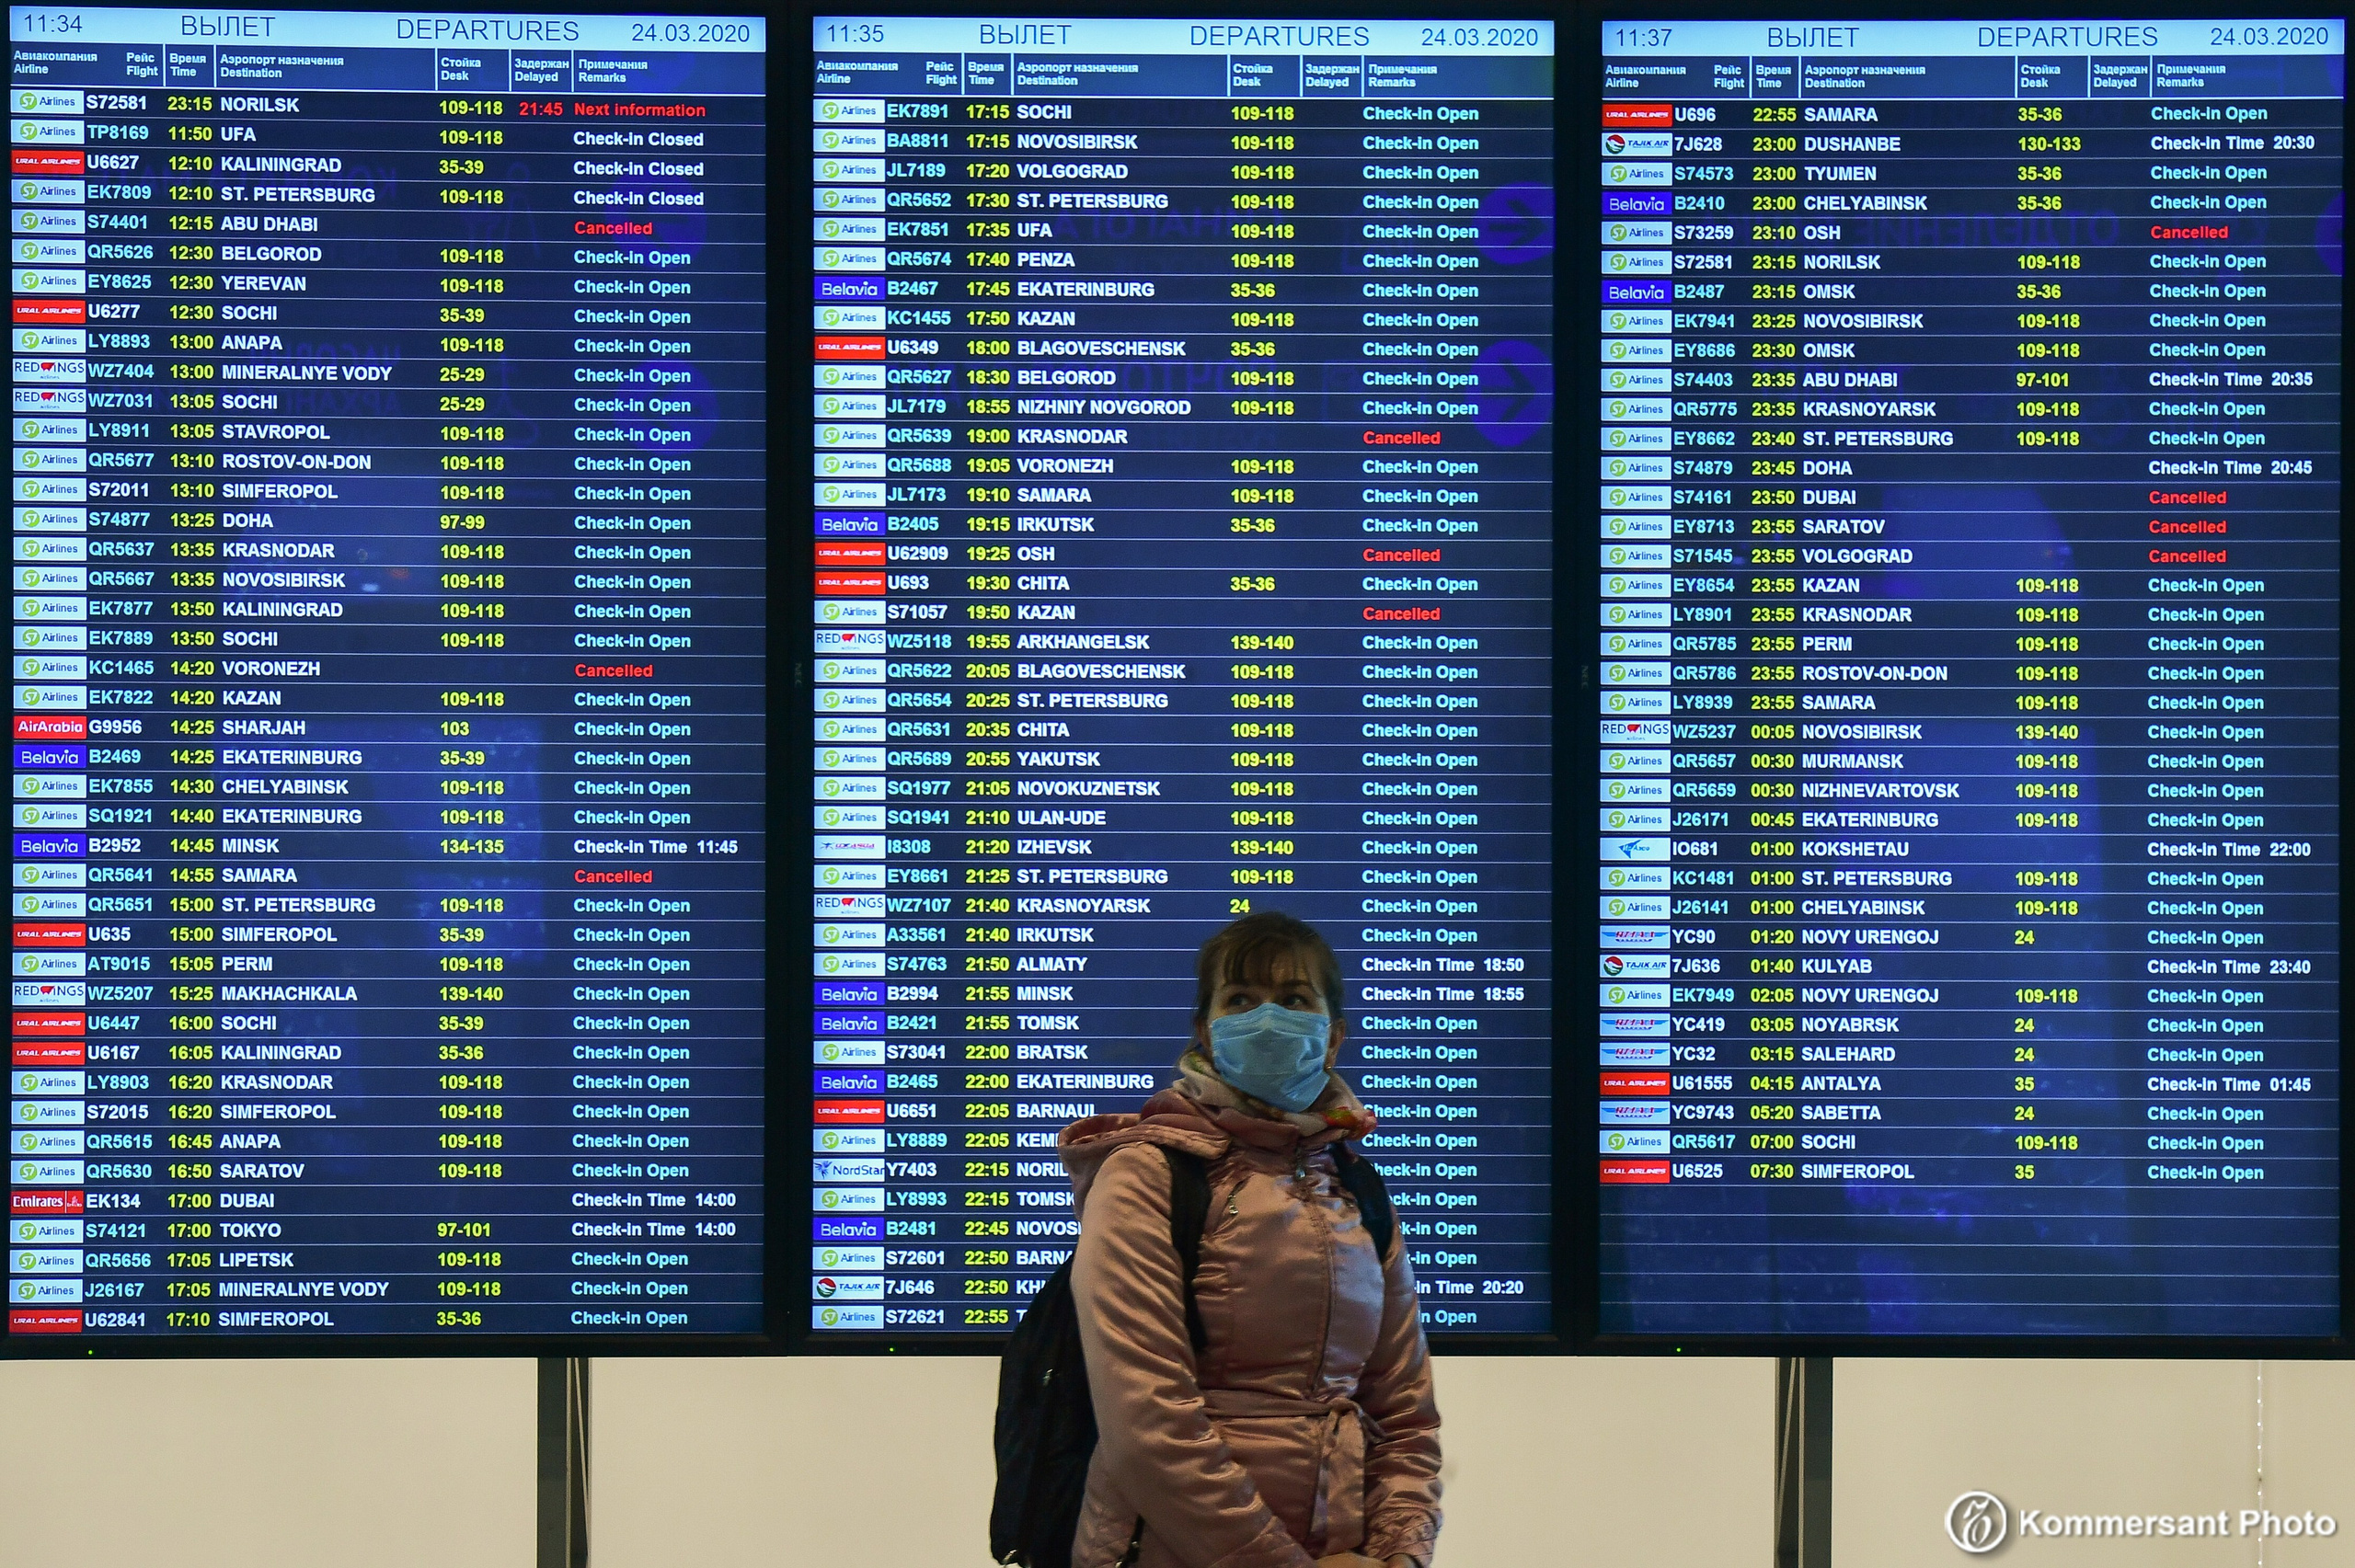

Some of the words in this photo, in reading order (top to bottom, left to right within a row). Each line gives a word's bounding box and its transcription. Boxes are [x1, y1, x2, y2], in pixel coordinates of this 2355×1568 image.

[25, 14, 82, 32] 11:34
[182, 16, 275, 37] ВЫЛЕТ
[397, 19, 579, 40] DEPARTURES
[632, 24, 750, 42] 24.03.2020
[828, 25, 883, 42] 11:35
[981, 25, 1072, 44] ВЫЛЕТ
[1191, 26, 1369, 46] DEPARTURES
[1422, 29, 1538, 46] 24.03.2020
[1616, 29, 1672, 46] 11:37
[1768, 28, 1859, 47] ВЫЛЕТ
[1979, 27, 2157, 47] DEPARTURES
[2211, 27, 2328, 45] 24.03.2020
[14, 51, 98, 61] Авиакомпания
[127, 52, 155, 63] Рейс
[170, 53, 206, 64] Время
[220, 54, 276, 66] Аэропорт
[278, 57, 343, 65] назначения
[442, 57, 481, 67] Стойка
[515, 58, 569, 70] Задержан
[579, 59, 648, 71] Примечания
[817, 61, 898, 71] Авиакомпания
[926, 62, 954, 71] Рейс
[968, 62, 1004, 73] Время
[14, 63, 48, 74] Airline
[127, 65, 158, 77] Flight
[170, 66, 196, 76] Time
[221, 67, 281, 77] Destination
[1017, 63, 1072, 74] Аэропорт
[1074, 64, 1138, 73] назначения
[1234, 63, 1273, 73] Стойка
[1305, 63, 1360, 75] Задержан
[1369, 64, 1437, 75] Примечания
[1606, 65, 1686, 74] Авиакомпания
[1715, 65, 1741, 74] Рейс
[1756, 65, 1791, 76] Время
[1805, 65, 1859, 76] Аэропорт
[2021, 64, 2061, 74] Стойка
[2094, 64, 2148, 75] Задержан
[2157, 64, 2225, 75] Примечания
[442, 71, 468, 80] Desk
[515, 72, 558, 83] Delayed
[579, 73, 626, 82] Remarks
[817, 74, 851, 83] Airline
[926, 74, 957, 86] Flight
[969, 74, 994, 85] Time
[1017, 75, 1078, 85] Destination
[1234, 76, 1261, 86] Desk
[1305, 77, 1349, 88] Delayed
[1369, 77, 1416, 86] Remarks
[1605, 78, 1638, 87] Airline
[1715, 78, 1744, 89] Flight
[1756, 78, 1781, 87] Time
[1805, 78, 1865, 87] Destination
[2021, 77, 2048, 87] Desk
[2094, 77, 2137, 89] Delayed
[2157, 77, 2204, 86] Remarks
[39, 96, 75, 107] Airlines
[86, 94, 146, 110] S72581
[167, 96, 213, 111] 23:15
[220, 97, 300, 113] NORILSK
[439, 99, 503, 115] 109-118
[519, 101, 564, 117] 21:45
[574, 102, 610, 116] Next
[615, 102, 706, 117] information
[841, 106, 877, 115] Airlines
[887, 103, 948, 119] EK7891
[966, 104, 1010, 120] 17:15
[1017, 104, 1072, 120] SOCHI
[1231, 106, 1294, 120] 109-118
[1362, 106, 1433, 120] Check-in
[1436, 106, 1479, 124] Open
[1673, 136, 1723, 152] 7J628
[1752, 136, 1797, 152] 23:00
[1804, 136, 1901, 152] DUSHANBE
[2018, 136, 2082, 152] 130-133
[2150, 135, 2221, 151] Check-in
[2225, 135, 2265, 150] Time
[2273, 135, 2315, 150] 20:30
[1628, 227, 1664, 237] Airlines
[1673, 224, 1734, 240] S73259
[1752, 225, 1797, 240] 23:10
[1803, 224, 1841, 240] OSH
[2150, 225, 2229, 239] Cancelled
[887, 545, 949, 561] U62909
[966, 545, 1011, 561] 19:25
[1017, 546, 1055, 562] OSH
[1362, 548, 1442, 562] Cancelled
[17, 720, 83, 733] AirArabia
[88, 719, 143, 735] G9956
[170, 719, 215, 735] 14:25
[222, 719, 306, 736] SHARJAH
[440, 721, 470, 736] 103
[574, 721, 645, 736] Check-in
[649, 722, 692, 739] Open
[1671, 724, 1737, 739] WZ5237
[1751, 724, 1795, 739] 00:05
[1802, 724, 1923, 739] NOVOSIBIRSK
[2015, 725, 2079, 739] 139-140
[2147, 725, 2218, 739] Check-in
[2222, 725, 2265, 742] Open
[842, 812, 878, 822] Airlines
[887, 809, 949, 825] SQ1941
[965, 809, 1010, 825] 21:10
[1017, 809, 1107, 826] ULAN-UDE
[1230, 810, 1294, 826] 109-118
[1361, 810, 1432, 826] Check-in
[1435, 811, 1478, 829] Open
[21, 838, 78, 853] Belavia
[88, 837, 142, 853] B2952
[170, 838, 214, 853] 14:45
[222, 838, 280, 853] MINSK
[440, 839, 504, 854] 134-135
[573, 839, 644, 853] Check-in
[648, 839, 688, 854] Time
[696, 840, 739, 854] 11:45
[821, 986, 878, 1001] Belavia
[887, 986, 939, 1001] B2994
[965, 986, 1010, 1001] 21:55
[1017, 986, 1074, 1001] MINSK
[1361, 986, 1431, 1001] Check-in
[1435, 987, 1476, 1001] Time
[1483, 987, 1525, 1001] 18:55
[1671, 1163, 1724, 1179] U6525
[1750, 1163, 1794, 1179] 07:30
[1800, 1163, 1915, 1179] SIMFEROPOL
[2015, 1164, 2035, 1180] 35
[2147, 1164, 2218, 1180] Check-in
[2222, 1165, 2265, 1184] Open
[13, 1195, 64, 1207] Emirates
[86, 1193, 142, 1208] EK134
[167, 1193, 212, 1208] 17:00
[220, 1193, 275, 1208] DUBAI
[571, 1192, 643, 1207] Check-in
[646, 1192, 686, 1207] Time
[695, 1192, 737, 1207] 14:00
